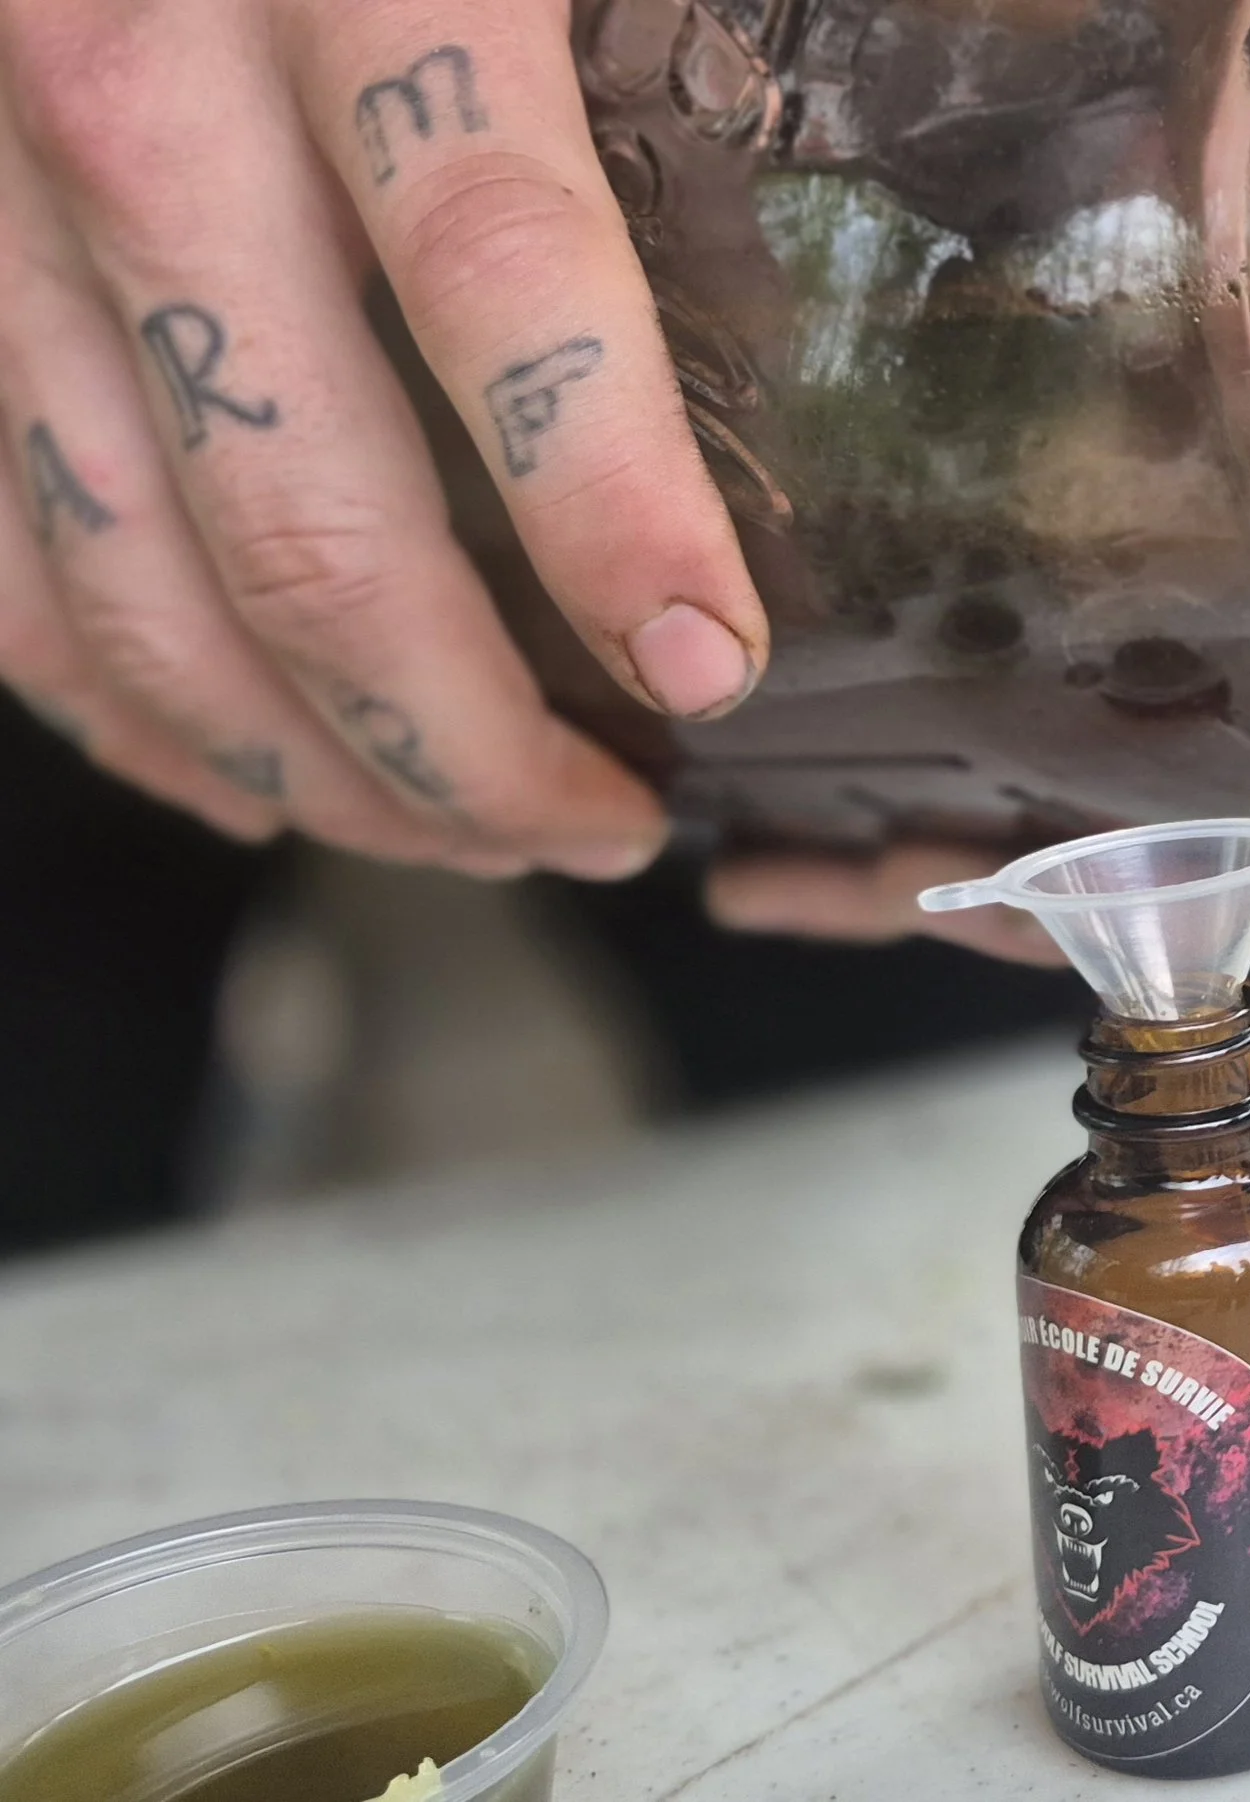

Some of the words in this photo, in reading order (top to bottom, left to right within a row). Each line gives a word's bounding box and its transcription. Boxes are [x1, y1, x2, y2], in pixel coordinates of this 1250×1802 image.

[140, 302, 281, 453] R
[26, 419, 118, 545] A
[1038, 1314, 1101, 1364] ÉCOLE
[1103, 1342, 1141, 1379] DE
[1140, 1359, 1236, 1432] SURVIE
[1063, 1651, 1158, 1691] SURVIVAL
[1149, 1600, 1226, 1676] SCHOOL
